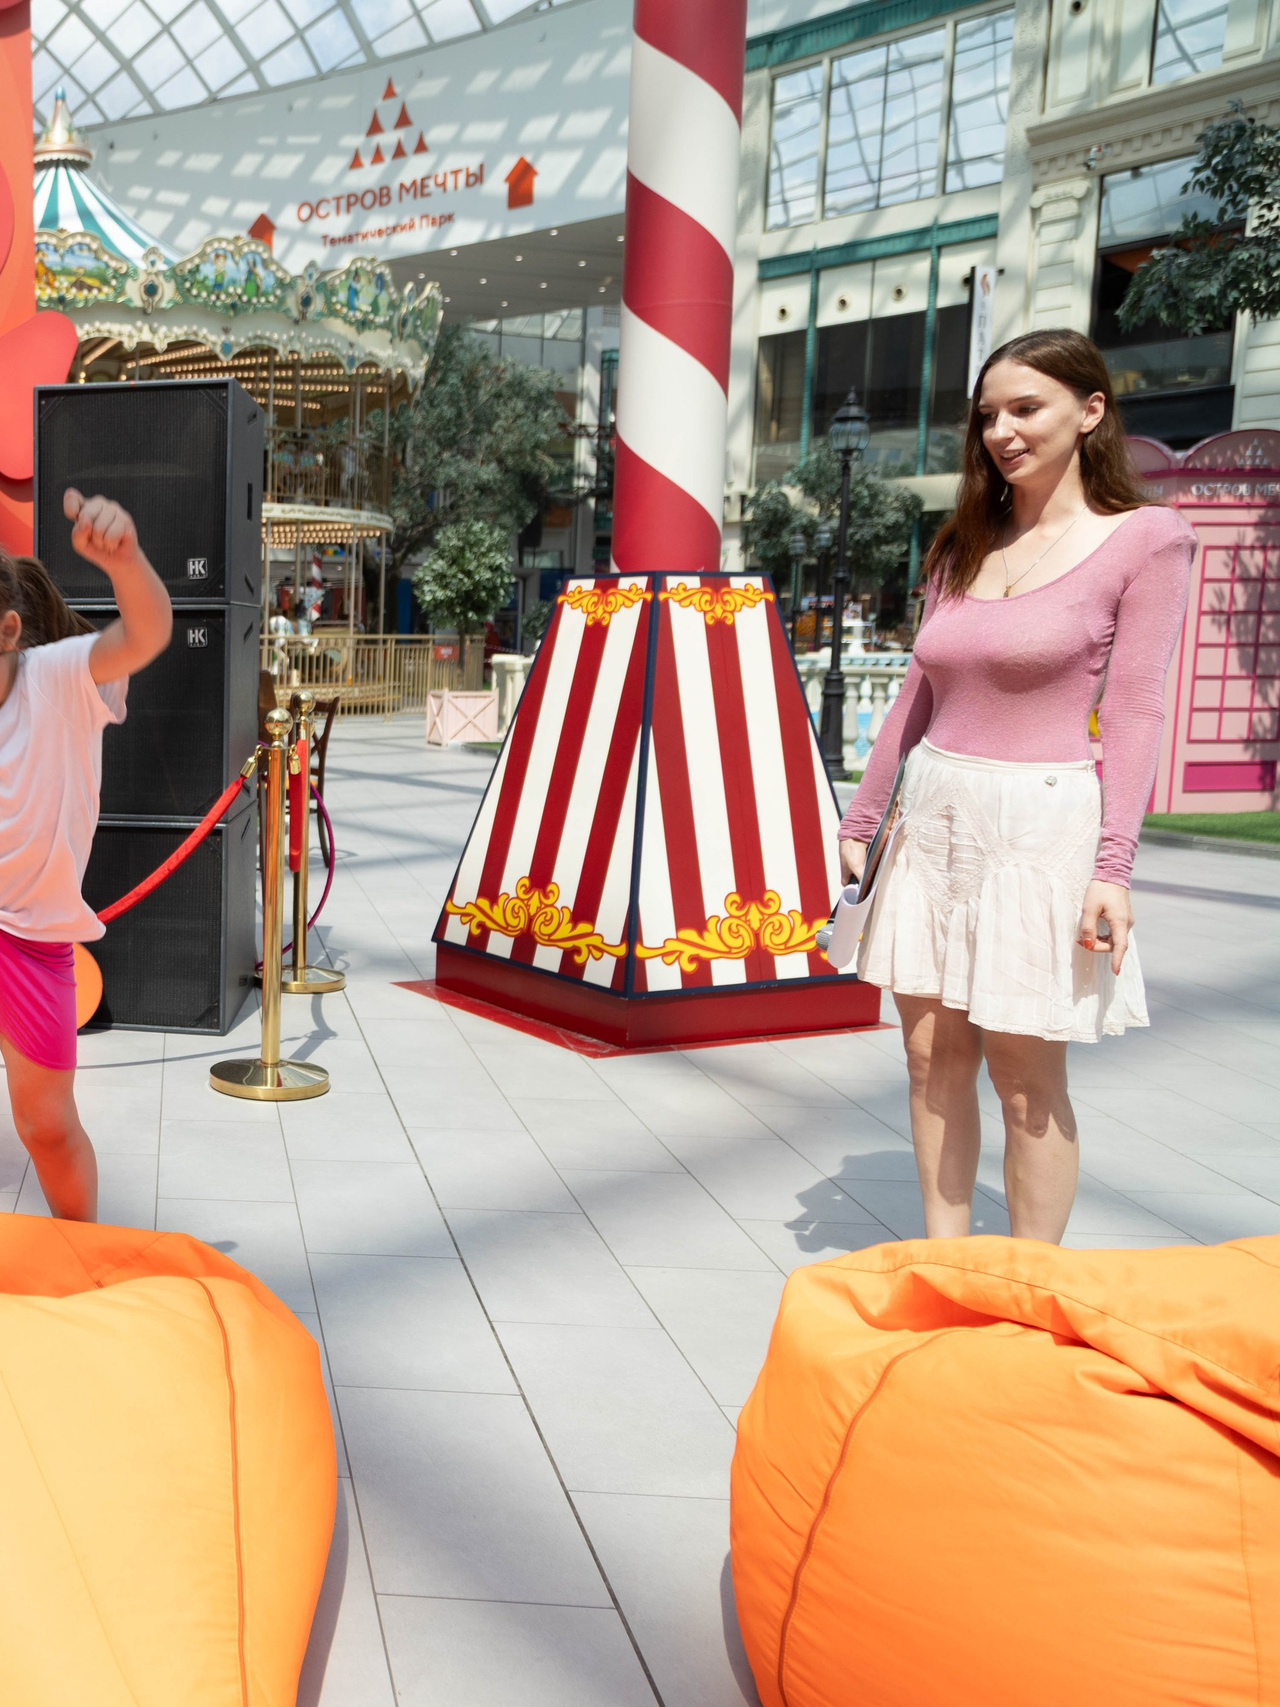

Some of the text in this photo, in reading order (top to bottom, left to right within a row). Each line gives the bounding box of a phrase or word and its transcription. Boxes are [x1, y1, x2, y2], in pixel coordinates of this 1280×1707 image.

[296, 163, 485, 223] ОСТРОВ МЕЧТЫ
[321, 210, 455, 248] Тематический Парк
[1191, 482, 1252, 496] ОСТРОВ
[189, 560, 206, 575] HK
[189, 629, 206, 644] HK
